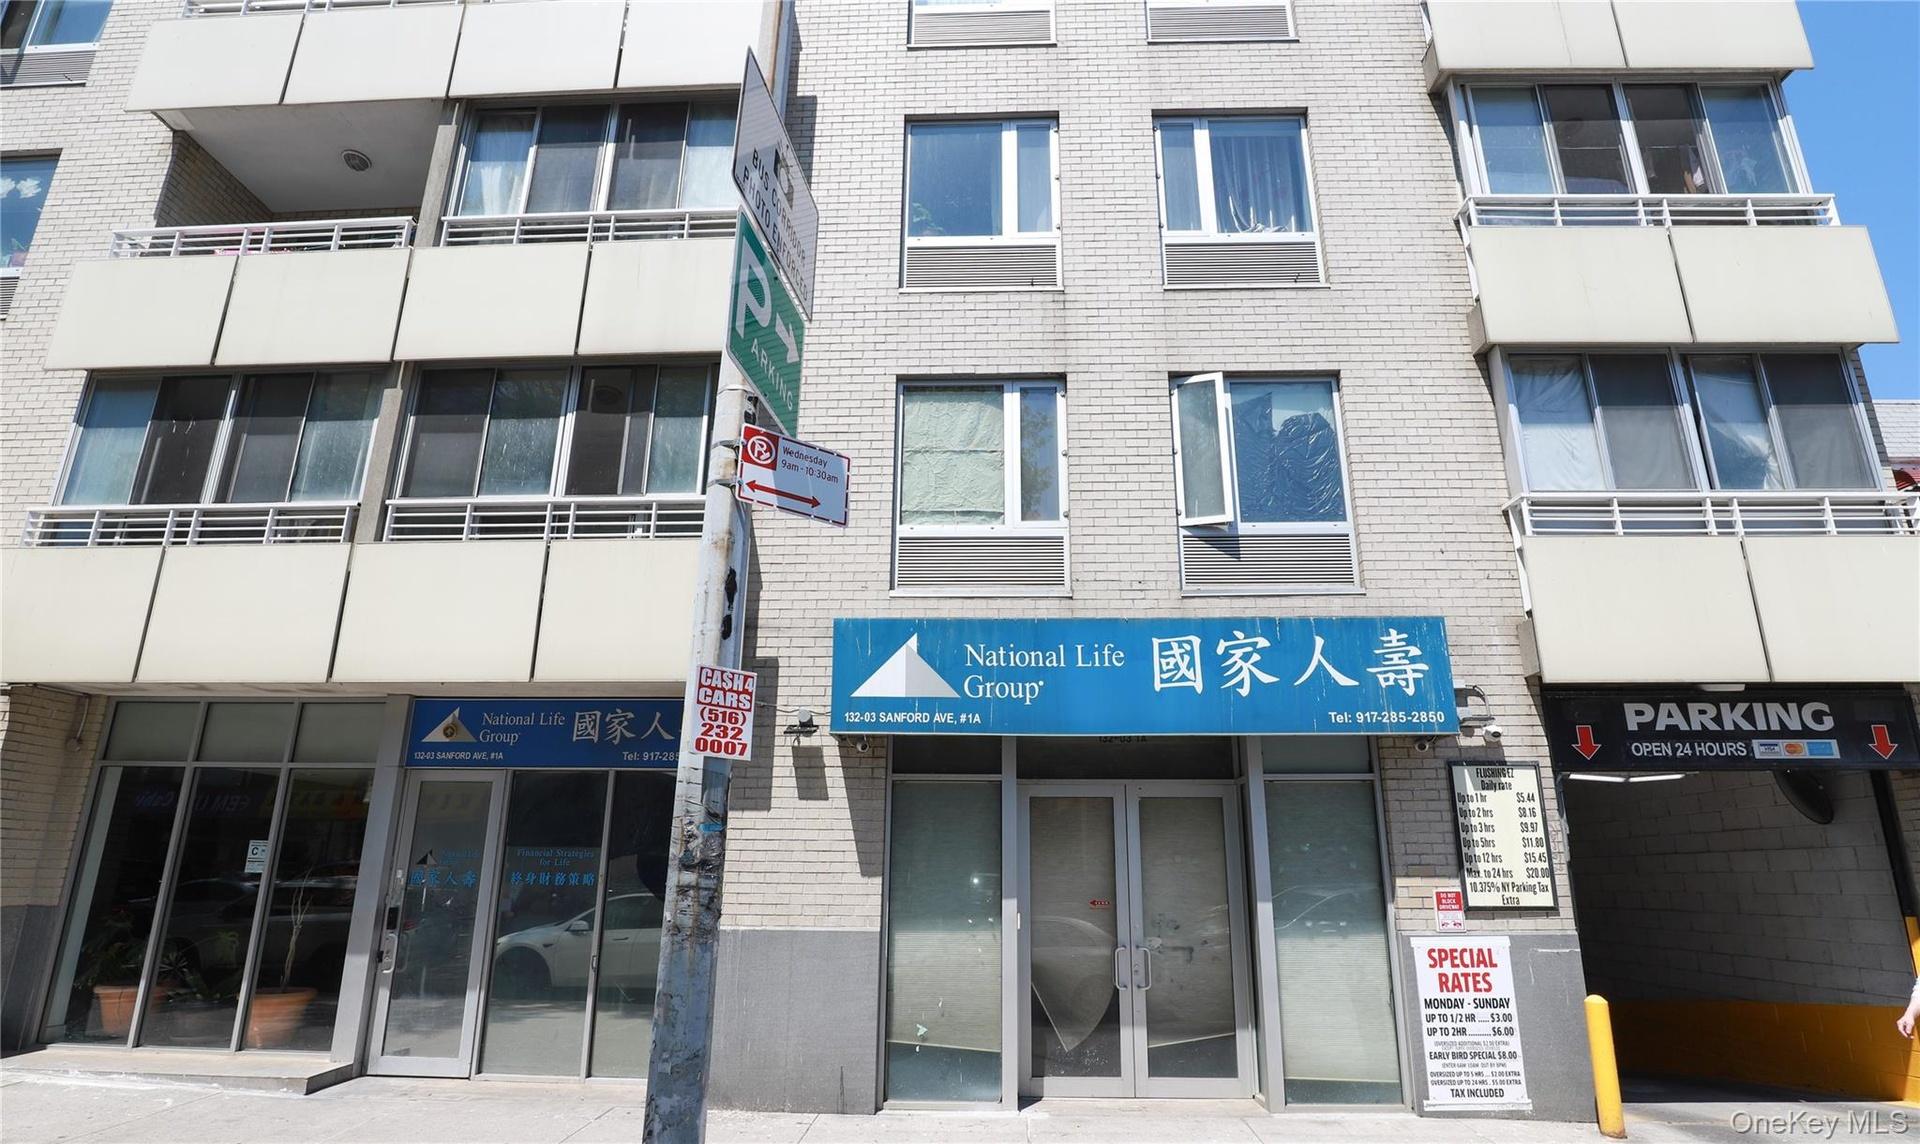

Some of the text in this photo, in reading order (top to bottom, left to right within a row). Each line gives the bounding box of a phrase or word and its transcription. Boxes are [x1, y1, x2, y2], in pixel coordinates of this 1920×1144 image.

[752, 149, 806, 267] BUS CORRIDOR
[743, 165, 808, 302] PHOTO ENFORCED
[783, 446, 828, 468] Wednesday
[781, 459, 799, 472] 9am
[805, 466, 838, 484] 10:30am
[964, 643, 1125, 667] National Life
[1151, 628, 1429, 698] 國家人壽
[744, 677, 754, 692] 4
[698, 687, 751, 710] CARS
[482, 712, 565, 726] National Life
[700, 707, 746, 726] (516)
[844, 712, 981, 725] 132-03 SANFORD AVE, #1A
[1328, 711, 1445, 723] Tel: 917-285-2850
[1623, 702, 1835, 732] PARKING
[572, 708, 683, 745] 國家人
[701, 722, 743, 741] 232
[479, 732, 520, 745] Group
[695, 738, 748, 756] 0007
[1631, 742, 1747, 756] OPEN 24 HOURS
[414, 752, 504, 761] 132-03 SANFORD AVE, #1A
[623, 752, 640, 761] Tel:
[1476, 768, 1514, 778] FLUSHING EZ
[1481, 780, 1512, 791] Daily rate
[1457, 792, 1465, 805] Up
[1467, 794, 1474, 802] to
[1480, 793, 1487, 802] hr
[1516, 792, 1535, 803] $5.44
[1459, 807, 1467, 820] Up
[1469, 809, 1476, 817] to
[1483, 808, 1493, 817] hrs
[1518, 807, 1537, 818] $8.16
[1461, 822, 1469, 834] Up
[1471, 824, 1478, 832] to
[1484, 823, 1495, 832] hrs
[1520, 822, 1538, 832] $9.97
[1463, 837, 1471, 850] Up
[1472, 839, 1479, 847] to
[1522, 837, 1544, 848] $11.80
[518, 849, 594, 859] Financial Strategies
[1464, 852, 1547, 865] Up to 12 hrs $15.45
[540, 858, 570, 867] for Life
[1484, 869, 1491, 878] to
[1492, 868, 1501, 878] 24
[1502, 868, 1513, 878] hrs
[1526, 867, 1550, 878] $20.00
[1470, 882, 1549, 895] 10.375% NY Parking Tax
[1502, 895, 1520, 905] Extra
[1427, 948, 1498, 968] SPECIAL
[1438, 972, 1493, 993] RATES
[1424, 998, 1465, 1009] MONDAY
[1473, 998, 1510, 1009] SUNDAY
[1425, 1013, 1513, 1024] UP TO 1/2 HR $3.00
[1427, 1027, 1514, 1036] UP TO 2HR $6.00
[1429, 1051, 1518, 1060] EARLY BIRD SPECIAL $8.00
[1451, 1089, 1504, 1097] TAX INCLUDED
